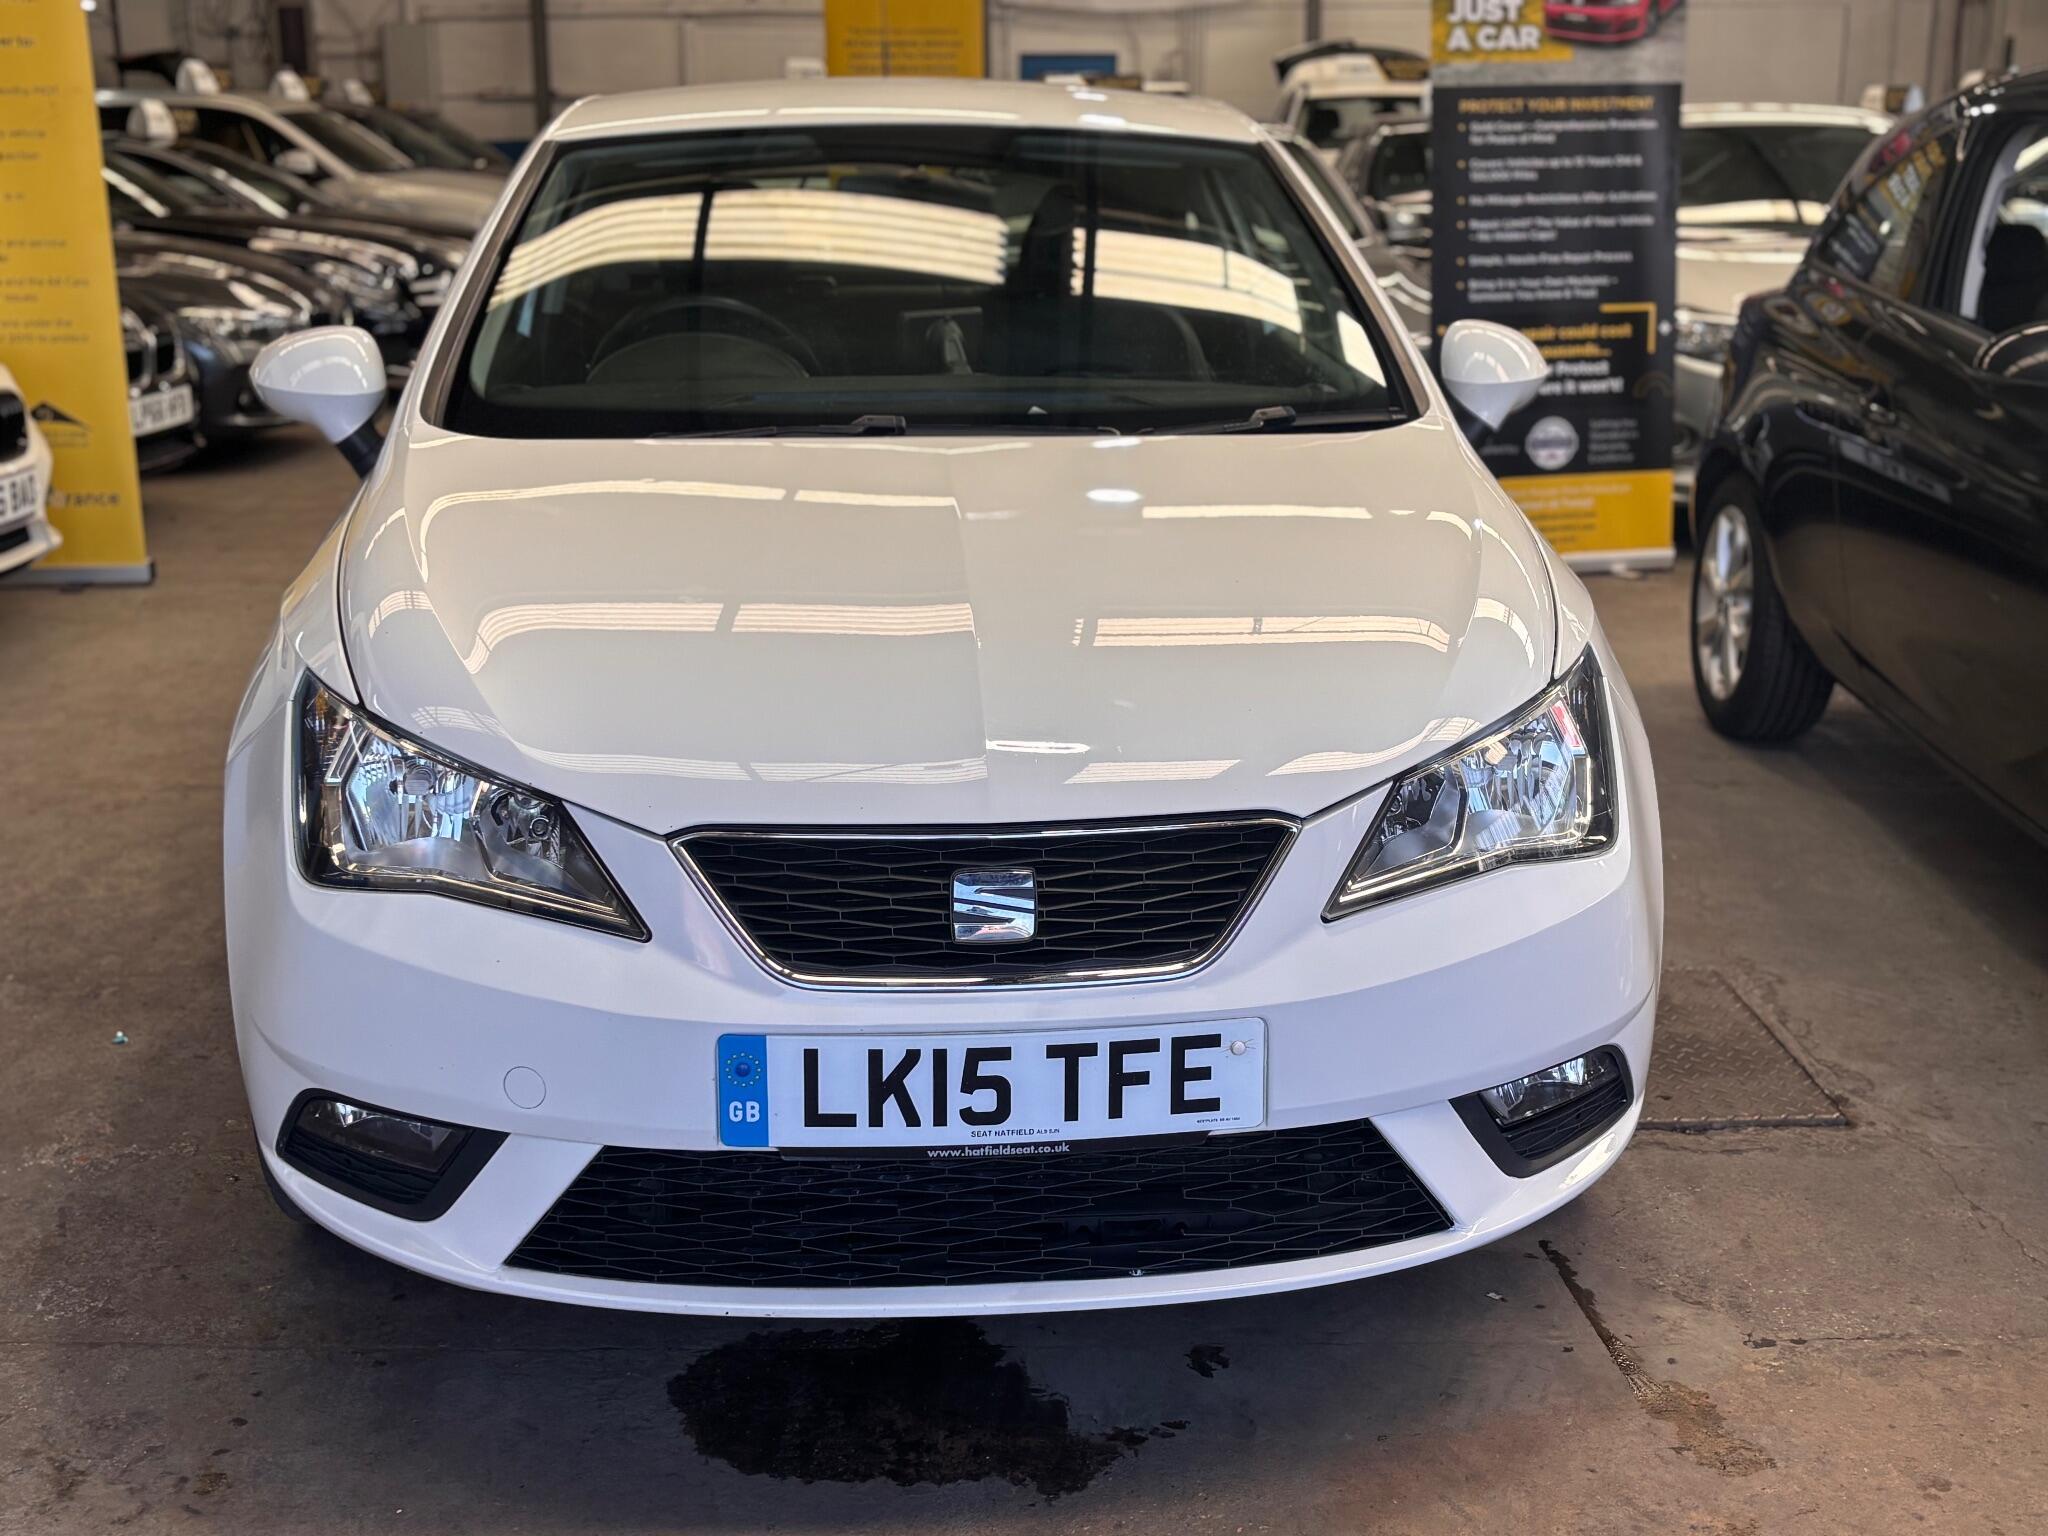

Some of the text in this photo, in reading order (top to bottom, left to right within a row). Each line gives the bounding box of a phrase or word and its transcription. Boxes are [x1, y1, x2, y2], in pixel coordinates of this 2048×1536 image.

[1447, 0, 1523, 22] JUST
[1447, 26, 1541, 50] A CAR
[1459, 96, 1654, 113] PROTECT YOUR INVESTMENT
[1558, 323, 1599, 341] could
[1600, 322, 1633, 340] cost
[1555, 359, 1610, 377] Protect
[52, 490, 121, 509] rance
[803, 1033, 1222, 1128] LK15 TFE
[728, 1101, 761, 1124] GB
[971, 1130, 992, 1138] SEAT
[994, 1128, 1035, 1137] HATFIELD
[927, 1142, 1070, 1157] www.hatfieldseat.co.uk
